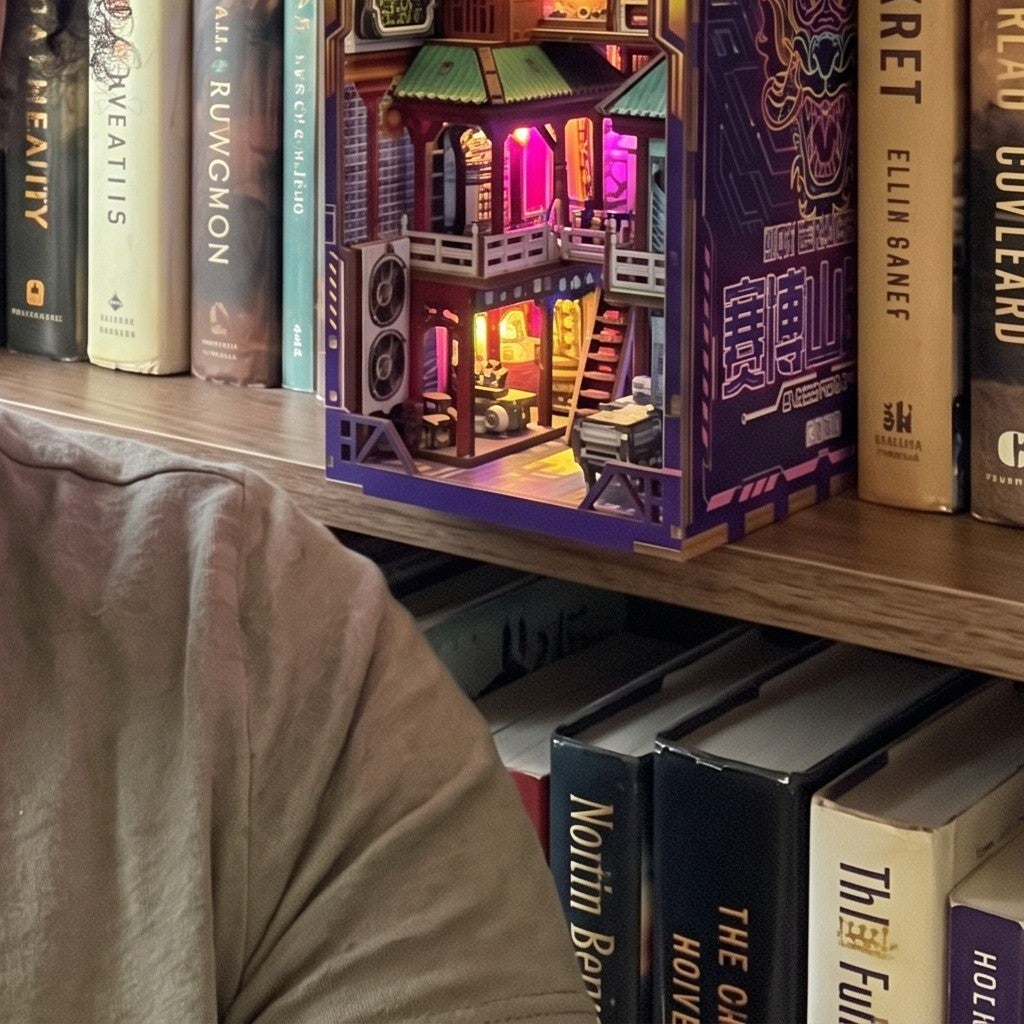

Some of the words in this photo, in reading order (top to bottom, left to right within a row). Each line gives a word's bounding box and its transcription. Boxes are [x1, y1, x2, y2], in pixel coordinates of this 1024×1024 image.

[208, 79, 231, 264] RUWGMON
[886, 148, 911, 222] ELLIN
[718, 906, 749, 973] THE
